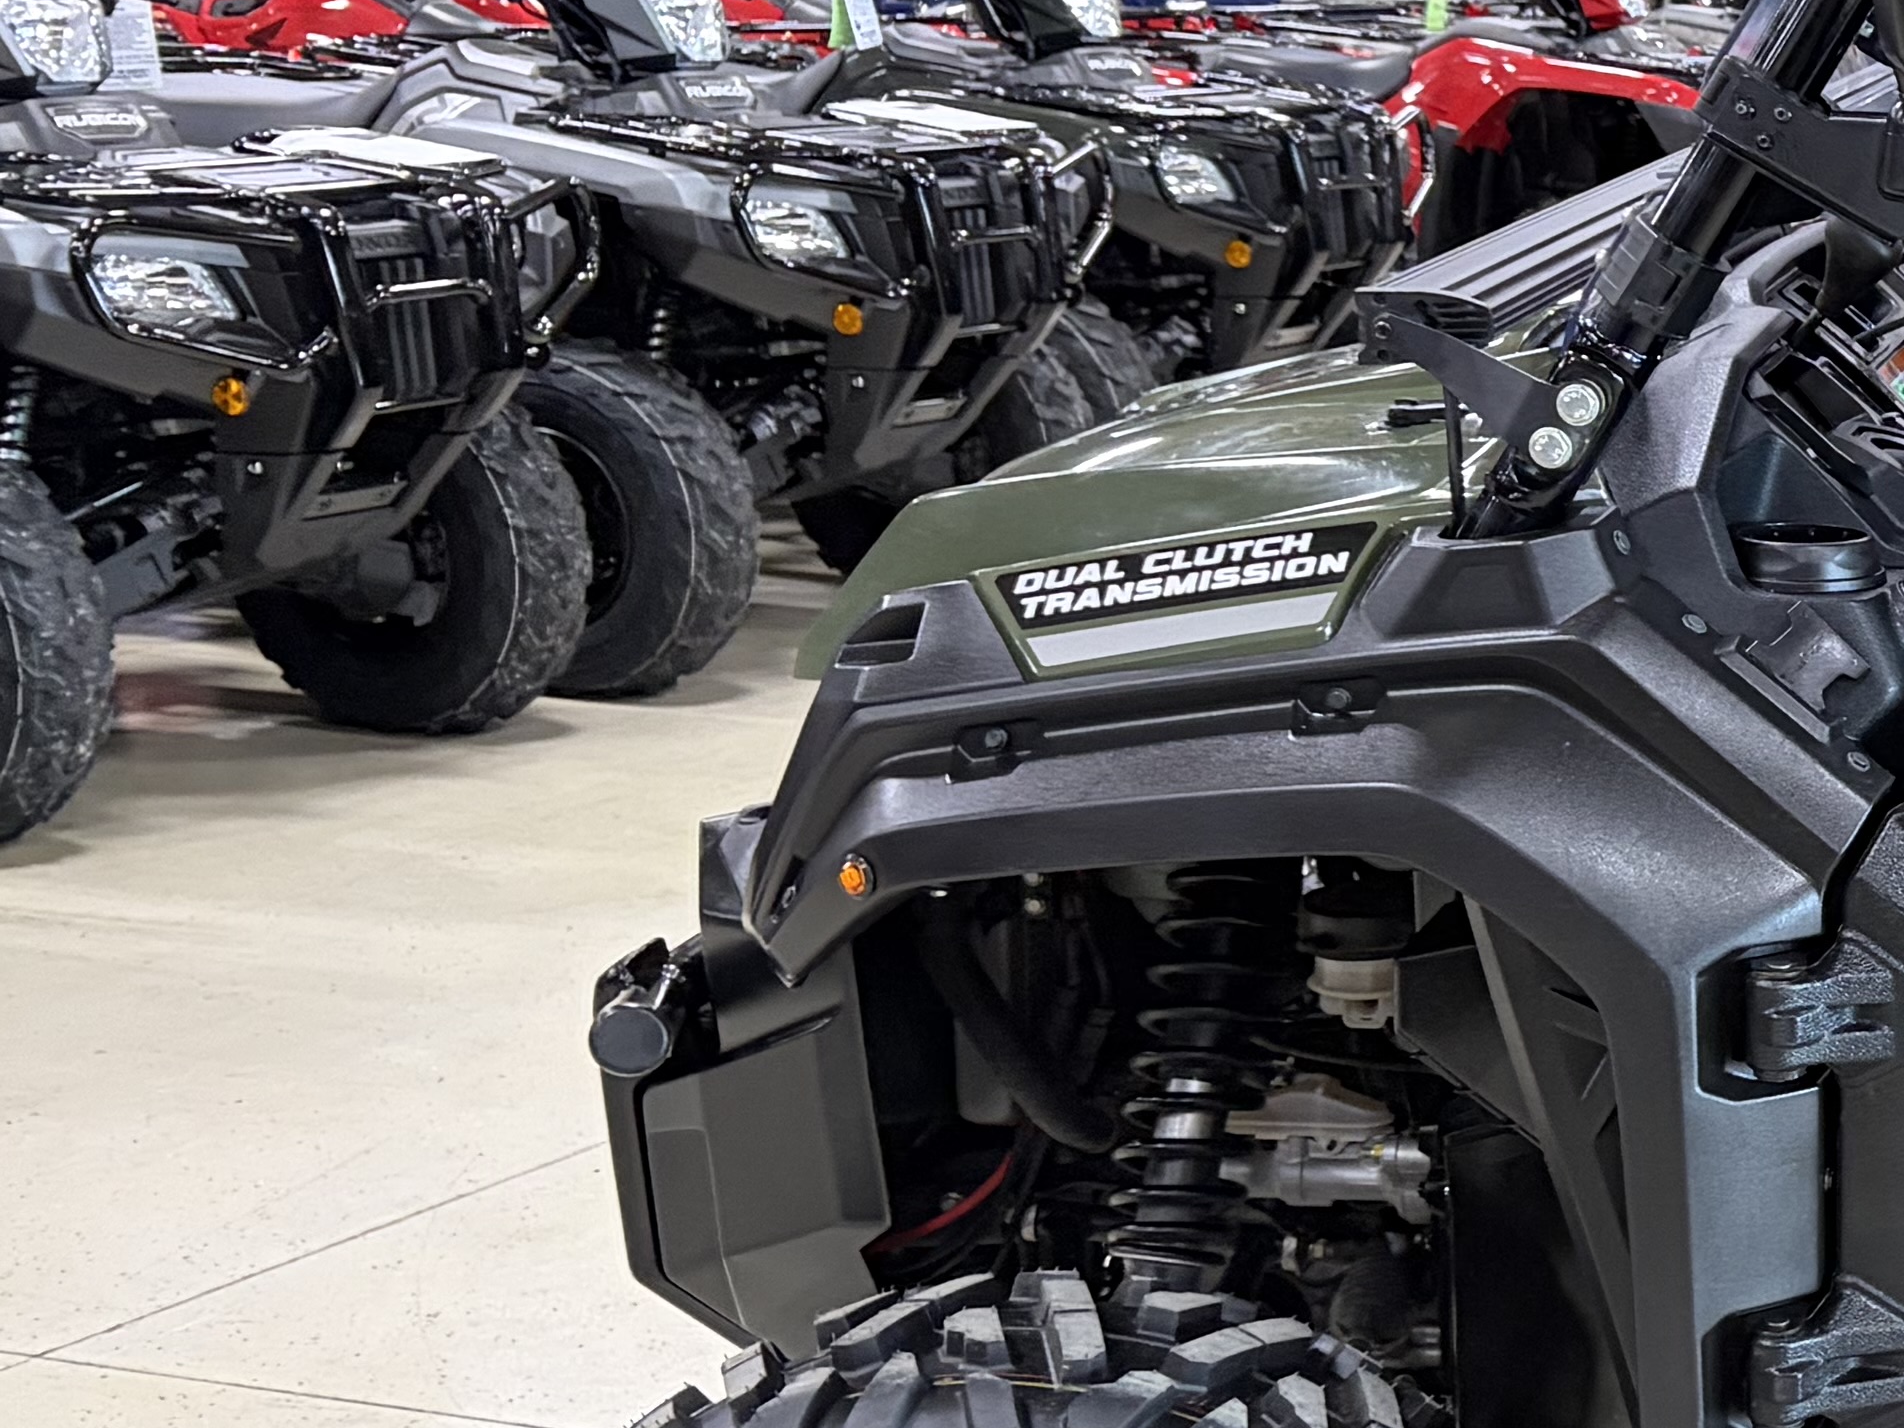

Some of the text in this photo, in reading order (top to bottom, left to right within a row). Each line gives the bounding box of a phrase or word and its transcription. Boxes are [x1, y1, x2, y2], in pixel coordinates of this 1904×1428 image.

[1013, 532, 1313, 595] DUAL CLUTCH
[1020, 551, 1350, 619] TRANSMISSION
